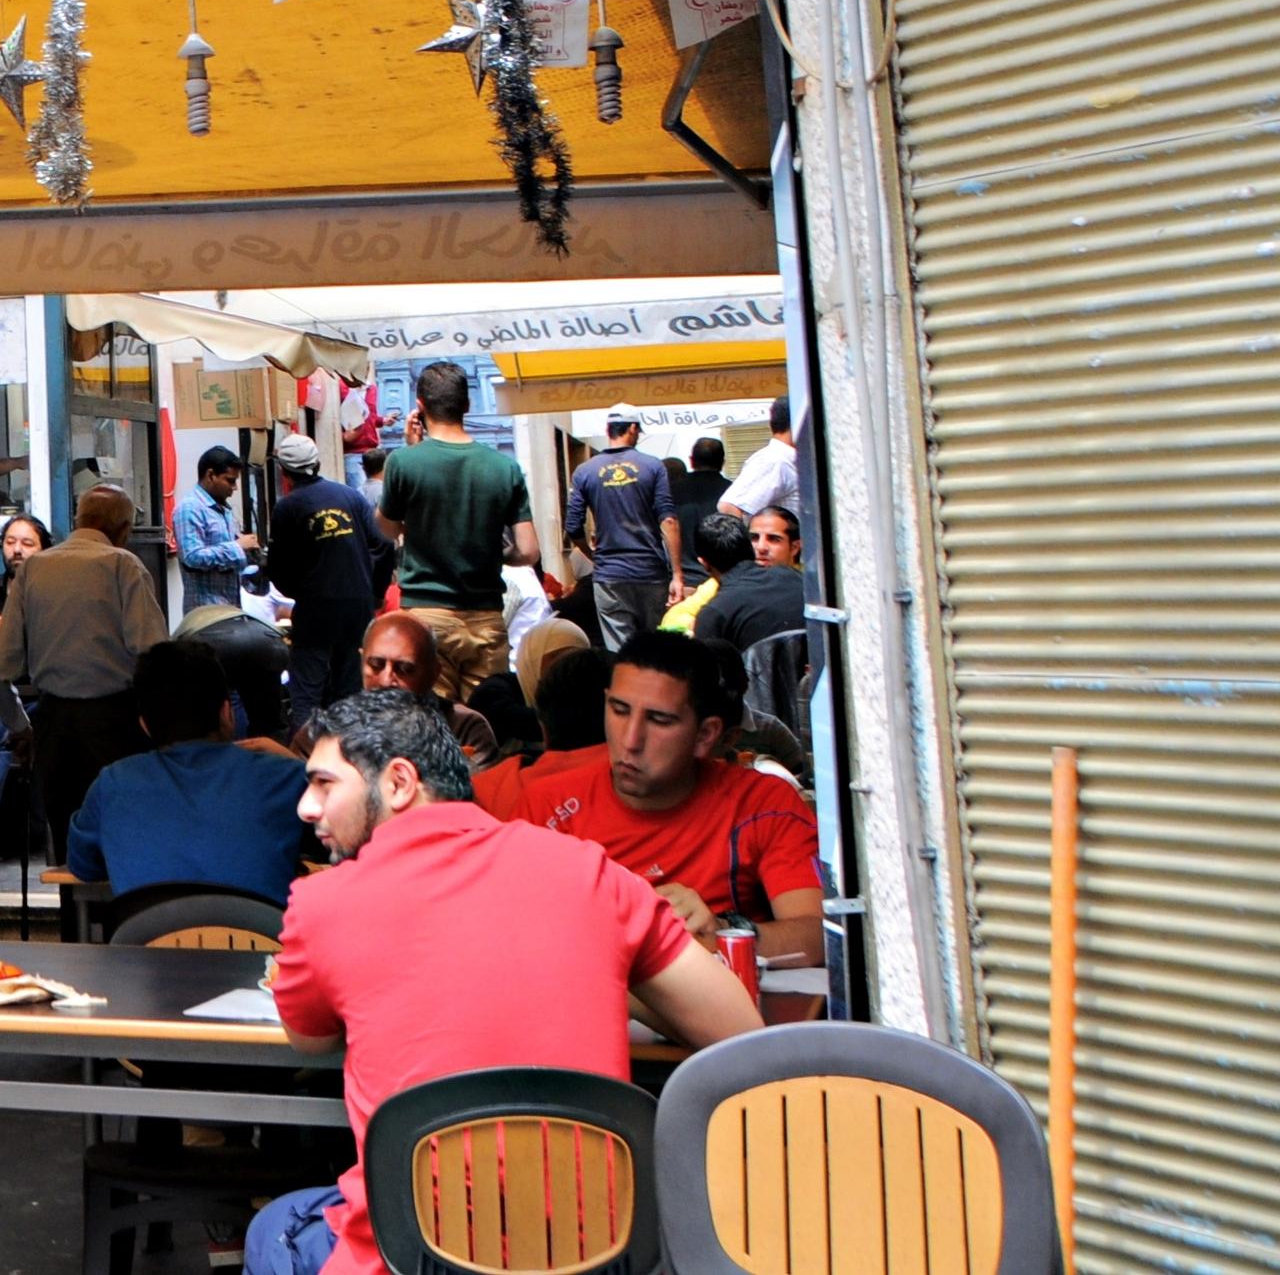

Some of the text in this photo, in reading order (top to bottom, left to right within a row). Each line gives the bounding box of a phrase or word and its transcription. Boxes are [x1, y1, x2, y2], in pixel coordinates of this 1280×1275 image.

[477, 318, 553, 350] الماضي
[559, 308, 642, 338] أصالة
[640, 410, 669, 426] الحا
